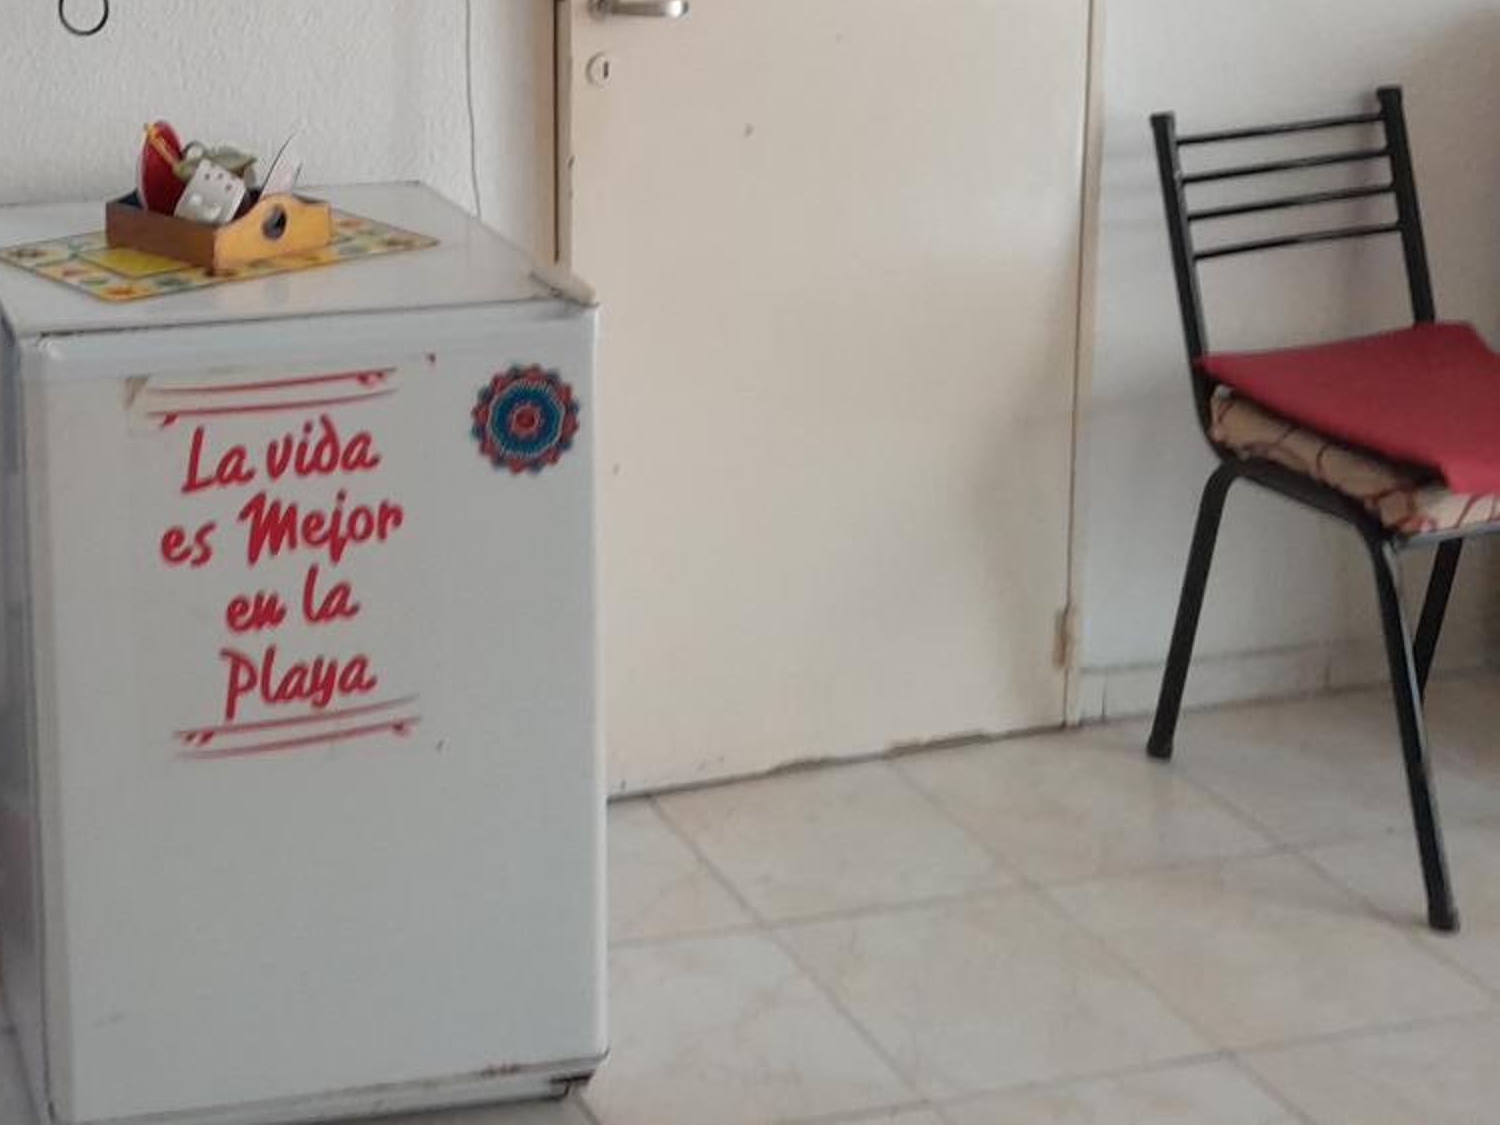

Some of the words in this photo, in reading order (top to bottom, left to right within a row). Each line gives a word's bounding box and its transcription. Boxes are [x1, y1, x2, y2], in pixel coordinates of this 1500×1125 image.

[181, 426, 257, 494] La
[266, 412, 382, 481] vida
[160, 522, 217, 567] es
[237, 488, 405, 567] Mejor
[225, 591, 287, 633] en
[302, 563, 360, 624] la
[218, 644, 378, 721] Playa
